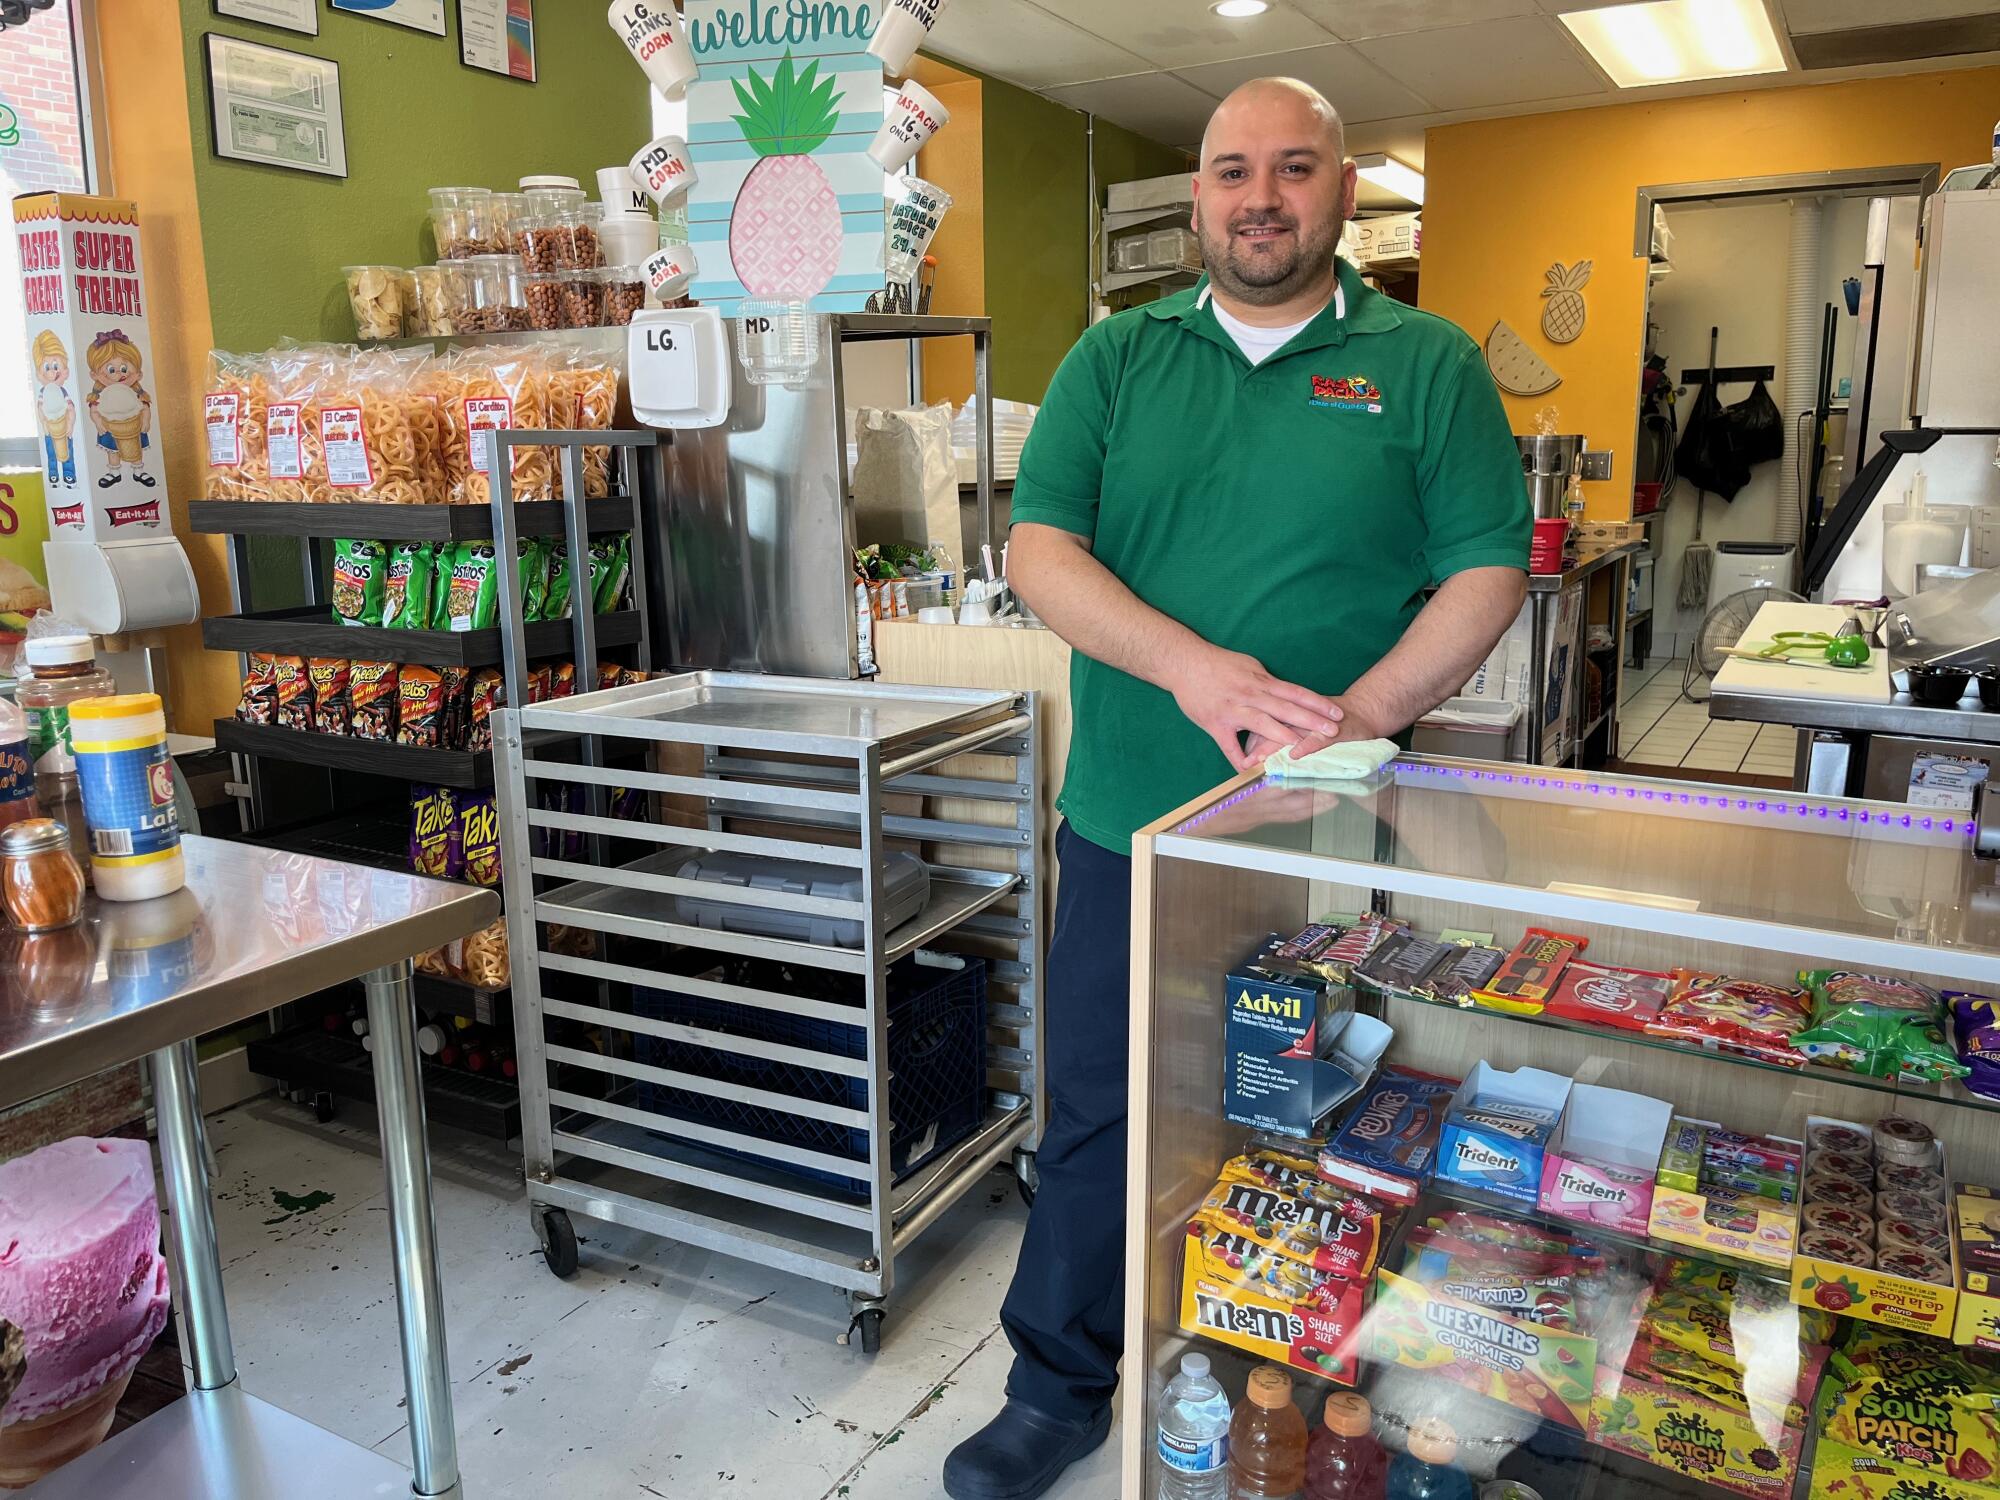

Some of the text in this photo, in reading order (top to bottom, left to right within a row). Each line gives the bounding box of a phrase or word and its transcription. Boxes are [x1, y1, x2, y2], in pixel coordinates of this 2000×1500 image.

[623, 3, 653, 30] LG.
[691, 0, 881, 53] welcome
[627, 12, 672, 50] DRINKS
[640, 32, 673, 61] CORN
[889, 125, 911, 143] ONLY
[901, 115, 916, 133] 16
[640, 146, 672, 174] MD.
[649, 158, 685, 192] CORN
[893, 217, 927, 239] JUICE
[18, 230, 61, 272] TASTES
[73, 230, 137, 273] SUPER
[648, 256, 671, 277] SM.
[651, 264, 682, 288] CORN
[23, 274, 65, 316] GREAT!
[74, 273, 143, 317] TREAT!
[745, 317, 774, 334] MD.
[647, 328, 677, 351] LG.
[325, 412, 333, 423] El
[468, 402, 477, 413] El
[414, 793, 454, 843] Takis
[1234, 989, 1301, 1019] Advil
[1232, 1015, 1242, 1023] Pain
[1243, 1053, 1269, 1064] Headache
[1243, 1061, 1284, 1075] Muscular Aches
[1242, 1076, 1290, 1091] Menstrual Cramps
[1243, 1068, 1258, 1076] Minor
[1258, 1072, 1270, 1080] Pain
[1277, 1077, 1299, 1085] Arthritis
[1242, 1091, 1257, 1099] Fever
[1243, 1083, 1270, 1095] Toothache
[1465, 1114, 1539, 1138] Trident
[1456, 1142, 1519, 1170] Trident
[1560, 1173, 1627, 1201] Trident
[1329, 1243, 1361, 1261] SHARE
[1332, 1252, 1349, 1267] SIZE
[1197, 1279, 1221, 1295] PEANUT
[1443, 1282, 1528, 1303] GUMMIES
[1869, 1289, 1905, 1306] Rosa
[1885, 1305, 1913, 1316] GIANT
[1909, 1297, 1922, 1309] la
[1925, 1301, 1944, 1312] de
[1196, 1293, 1304, 1344] m&m's
[1308, 1316, 1343, 1337] SHARE
[1426, 1300, 1541, 1356] LIFE SAVERS
[1314, 1330, 1334, 1345] SIZE
[1435, 1330, 1524, 1372] GUMMIES
[1861, 1393, 1951, 1432] SOUR
[1163, 1434, 1196, 1451] KIRKLAND
[1659, 1418, 1724, 1451] SOUR
[1857, 1417, 1955, 1456] PATCH
[1656, 1434, 1726, 1467] PATCH
[1895, 1442, 1934, 1462] Kids
[1683, 1456, 1710, 1471] Kids
[1853, 1457, 1878, 1467] SOUR
[1725, 1467, 1784, 1487] Watermelon
